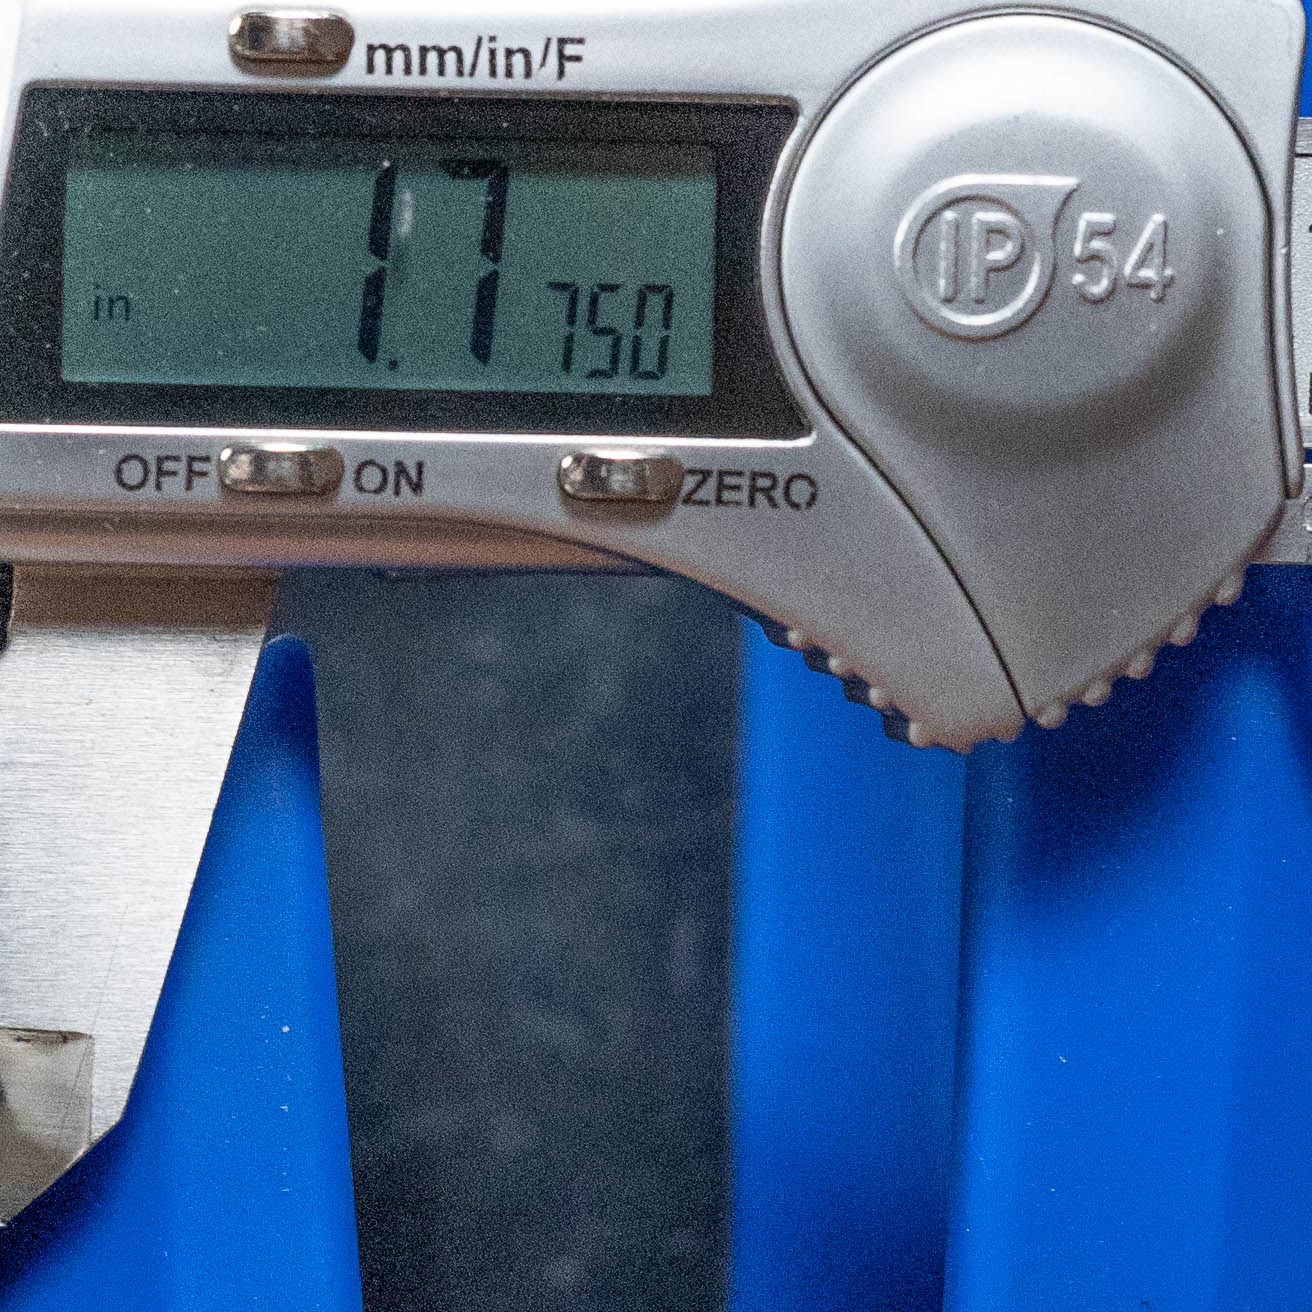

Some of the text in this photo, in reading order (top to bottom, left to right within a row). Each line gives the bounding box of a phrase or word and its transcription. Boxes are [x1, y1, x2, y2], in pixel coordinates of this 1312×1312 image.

[365, 35, 586, 81] mm/in/F
[937, 210, 1175, 305] IP 54
[91, 284, 132, 322] in
[112, 452, 427, 498] OFF ON
[682, 465, 822, 514] ZERO
